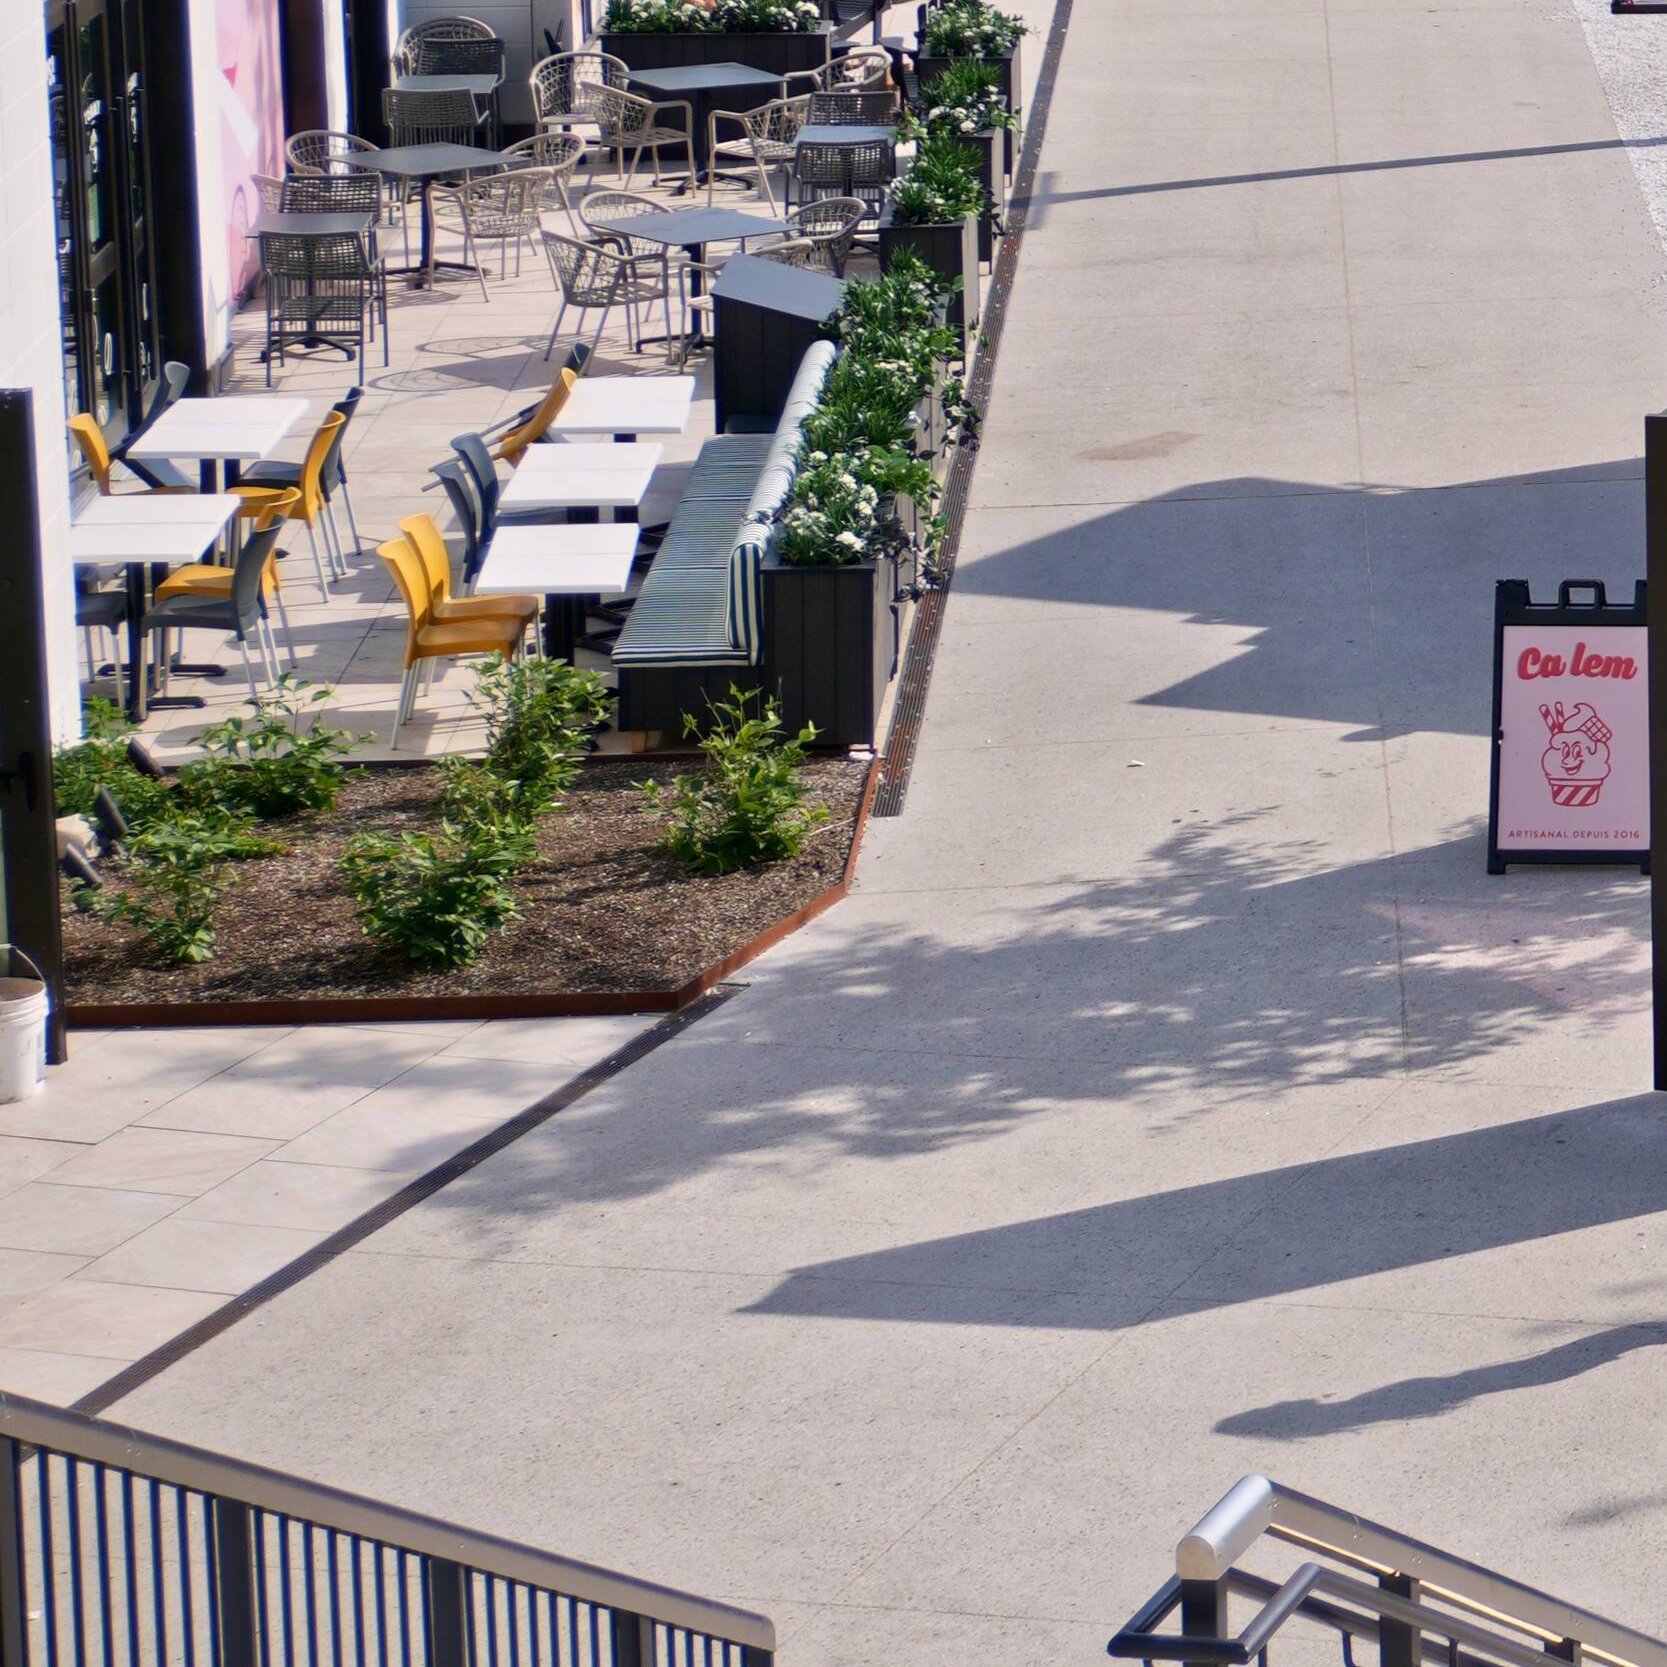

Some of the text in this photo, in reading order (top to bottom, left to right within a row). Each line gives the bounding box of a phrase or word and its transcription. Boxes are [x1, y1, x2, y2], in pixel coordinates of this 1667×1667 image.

[1517, 642, 1638, 680] Ca lem
[1508, 829, 1640, 839] ARTISANAL DEPUIS 2016
